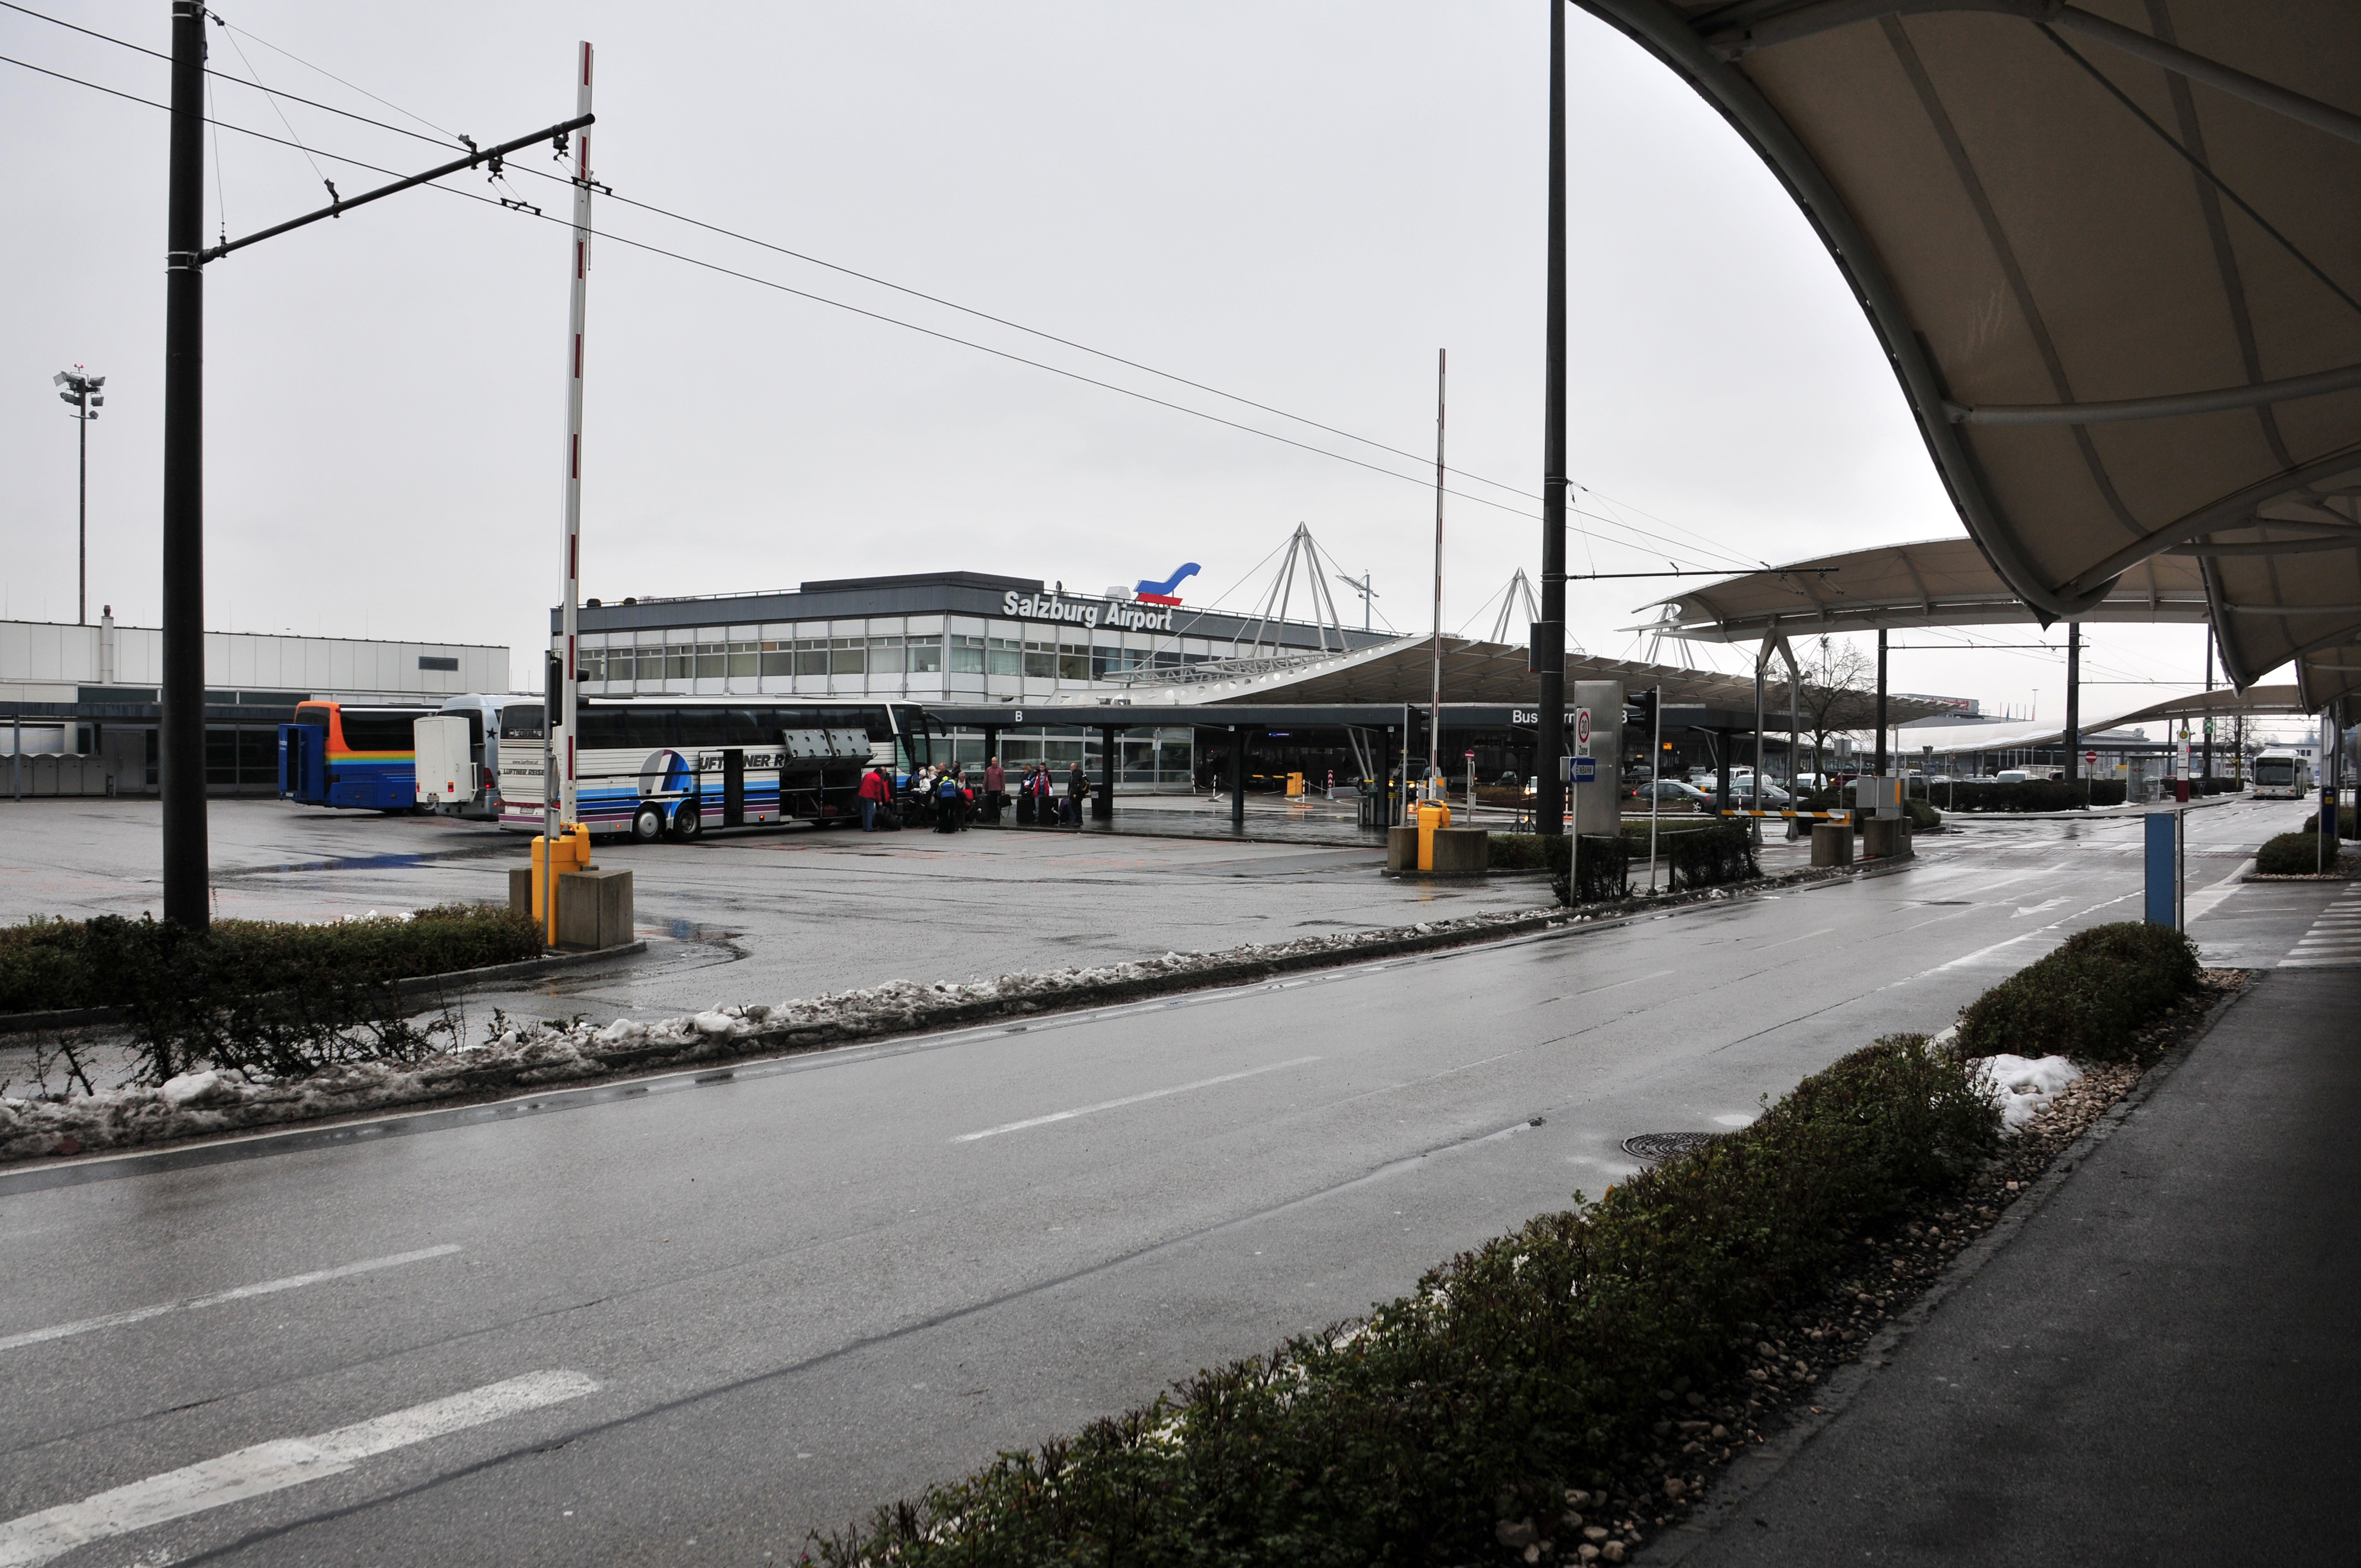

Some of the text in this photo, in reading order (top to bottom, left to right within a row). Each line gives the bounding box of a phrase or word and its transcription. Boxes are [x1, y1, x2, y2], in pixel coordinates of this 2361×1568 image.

[1003, 591, 1173, 631] Salzburg Airport
[1015, 710, 1023, 722] B
[1513, 710, 1538, 723] Bus
[1581, 720, 1587, 734] 30
[1579, 745, 1588, 755] Zone
[1576, 765, 1592, 774] EINBAHN
